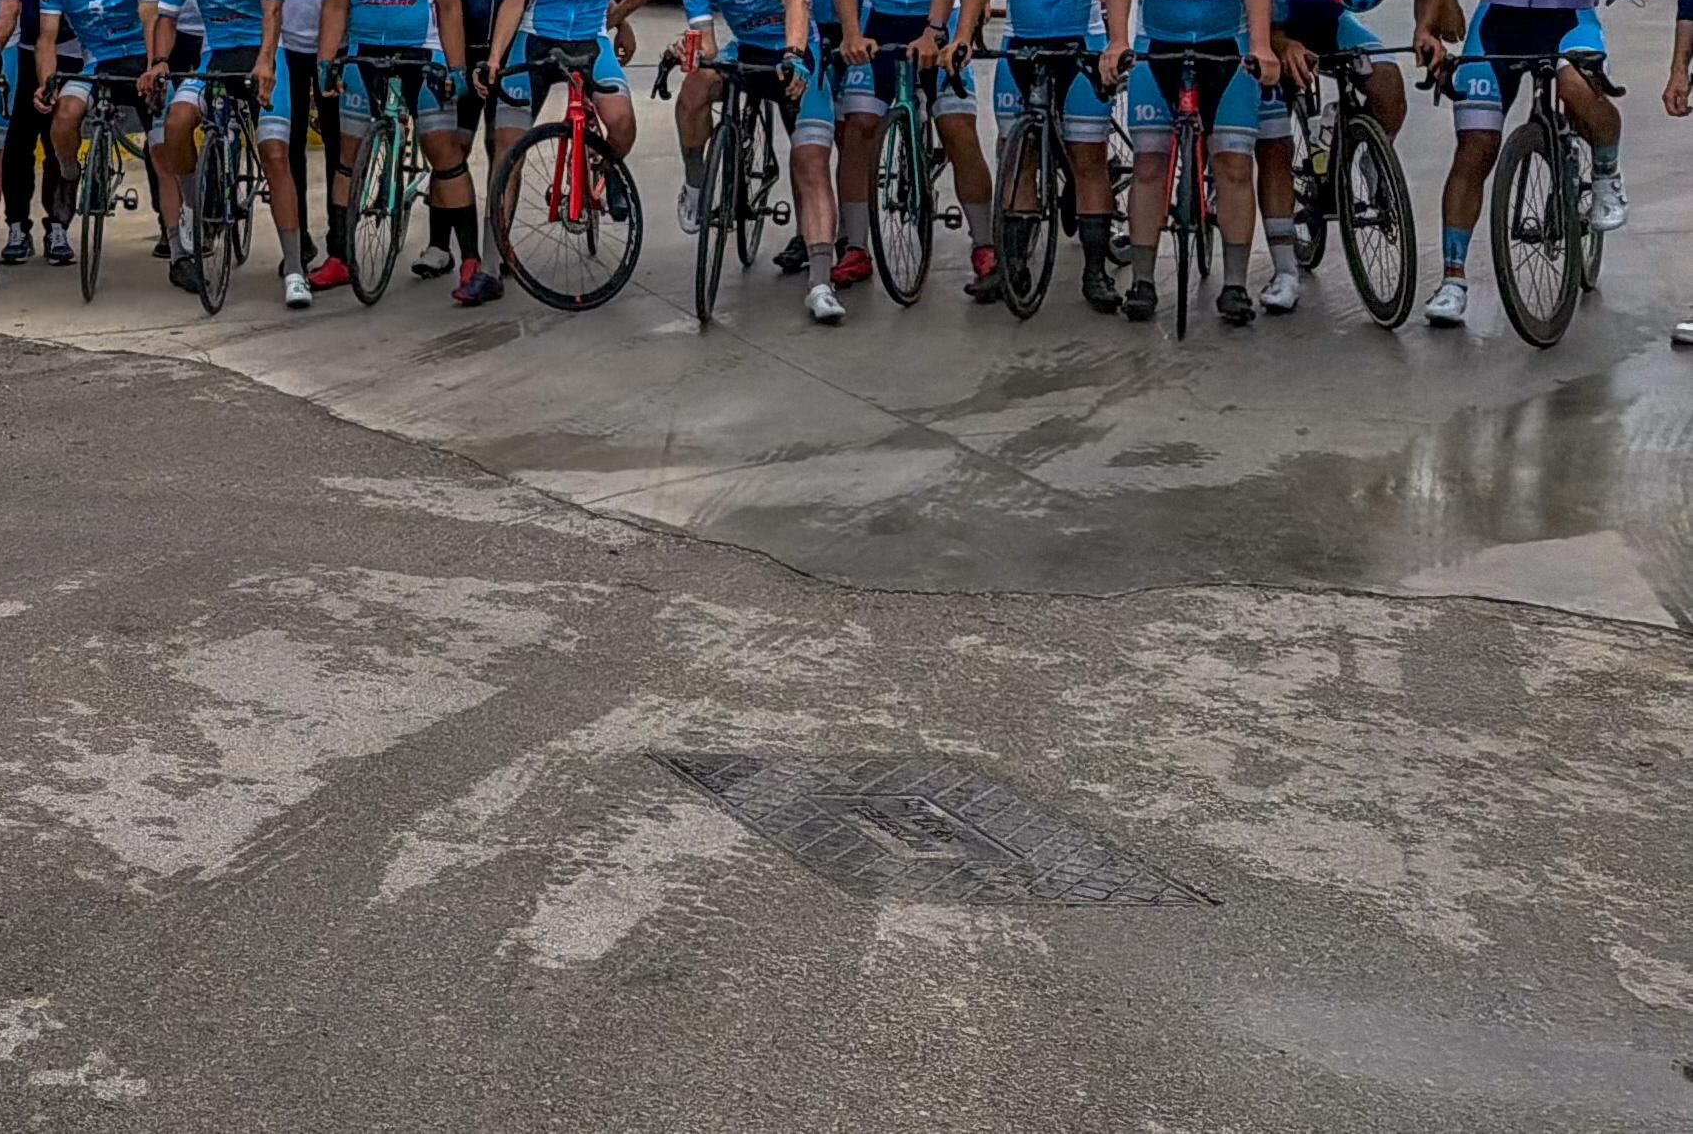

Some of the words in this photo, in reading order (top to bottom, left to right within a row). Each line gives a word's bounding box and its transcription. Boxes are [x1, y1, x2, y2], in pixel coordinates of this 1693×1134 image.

[1468, 79, 1491, 96] 10
[345, 95, 361, 107] 10
[997, 93, 1013, 108] 10
[1134, 105, 1155, 121] 10
